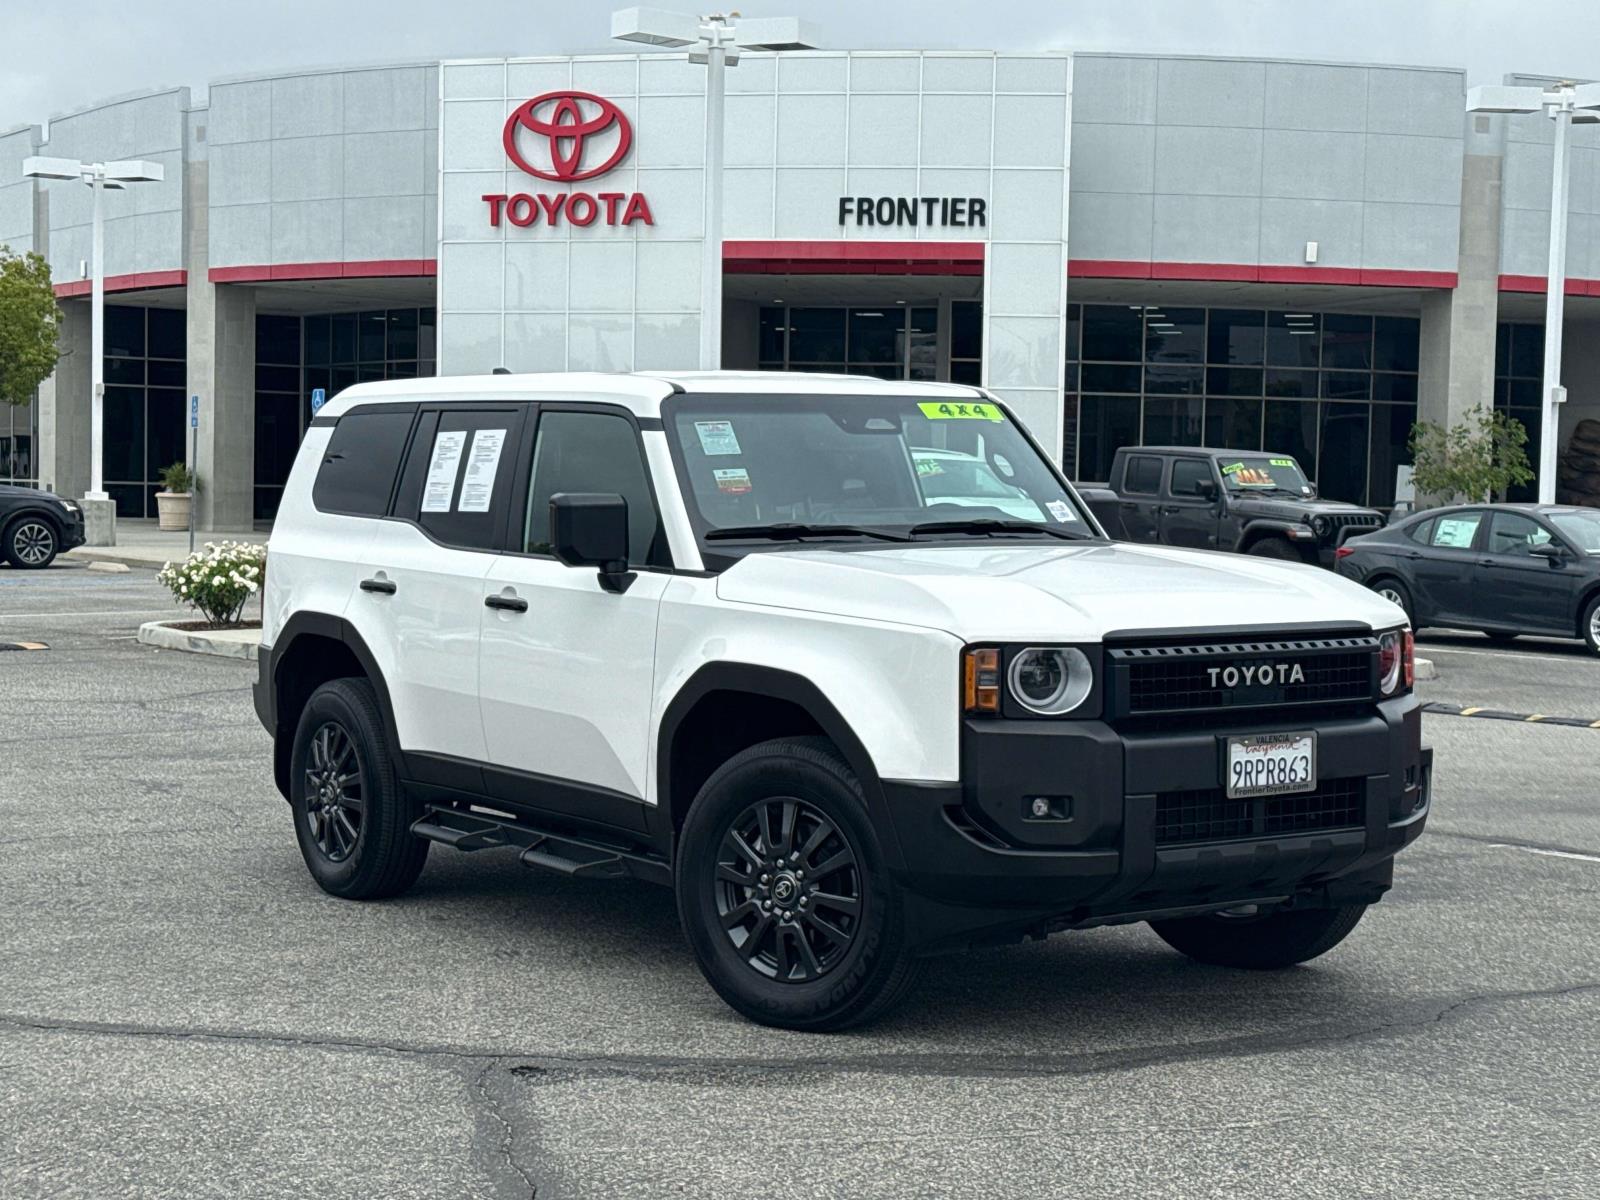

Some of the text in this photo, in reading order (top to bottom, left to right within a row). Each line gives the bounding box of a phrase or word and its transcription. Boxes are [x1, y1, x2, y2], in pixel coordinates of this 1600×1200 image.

[482, 193, 653, 227] TOYOTA
[838, 197, 987, 227] FRONTIER
[1207, 664, 1305, 687] TOYOTA
[1255, 734, 1290, 744] VALENCIA
[1232, 755, 1309, 788] 9RPR863
[1234, 784, 1309, 796] FrontierToyota.com
